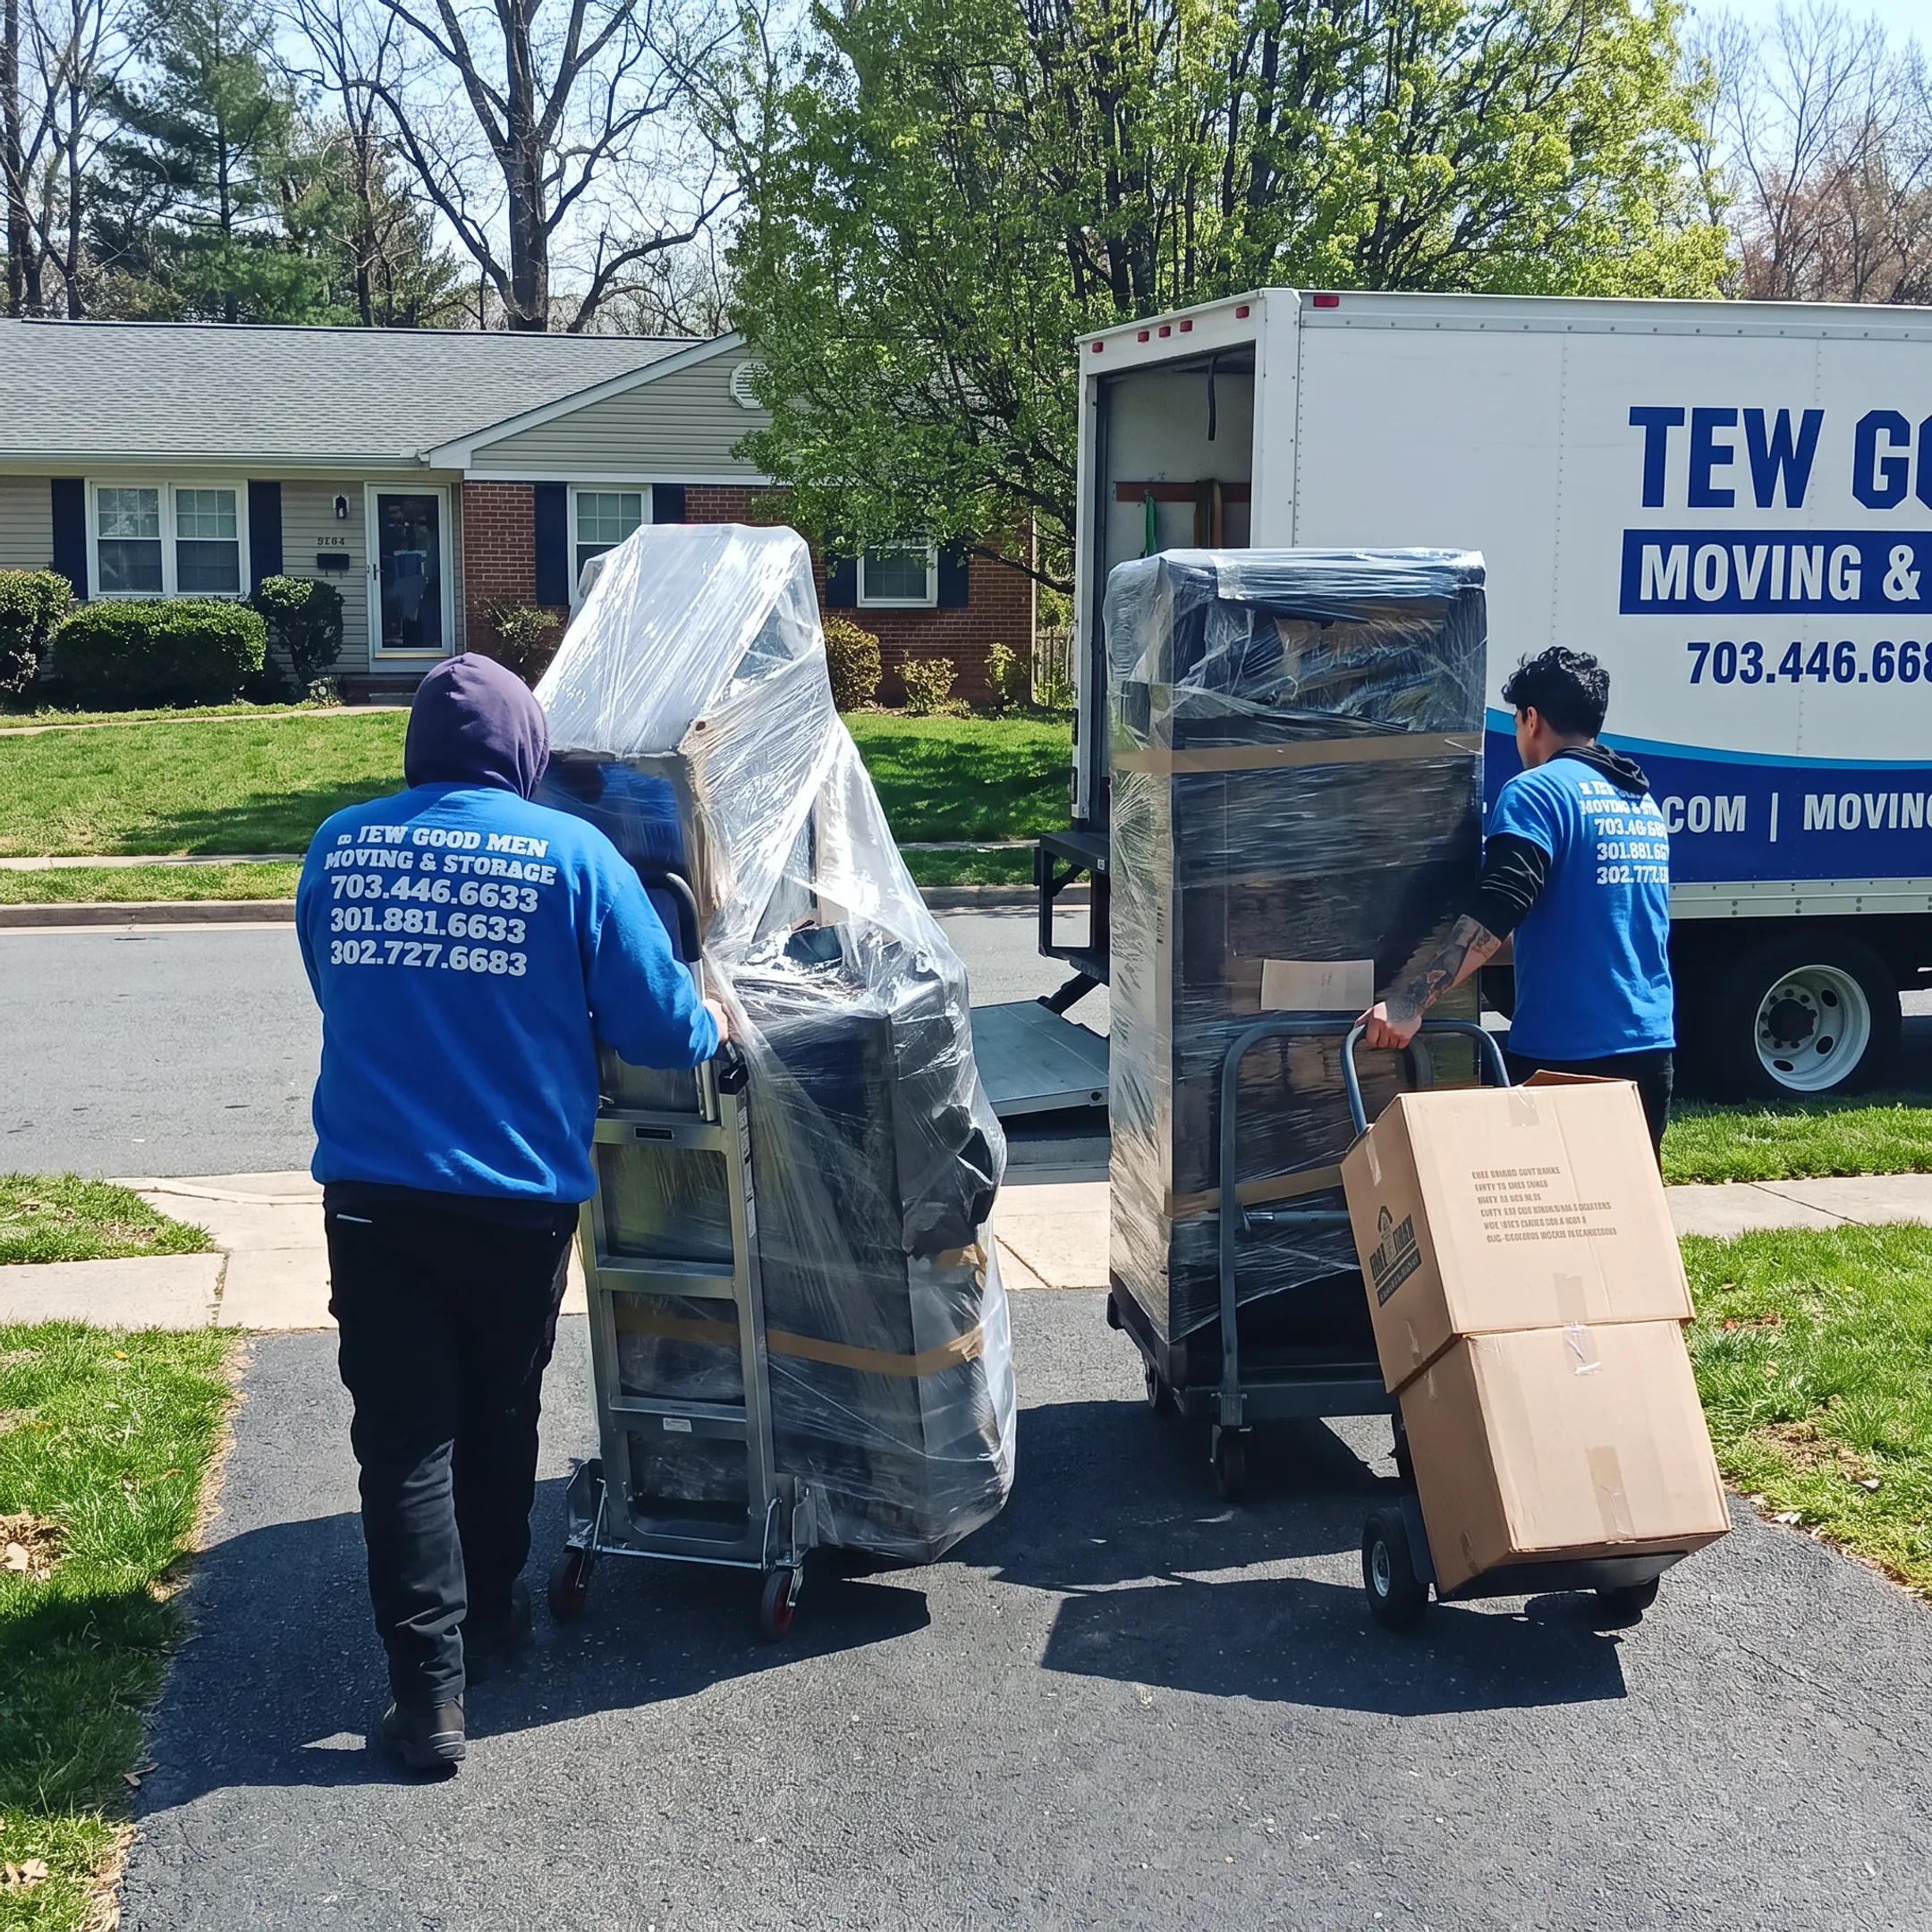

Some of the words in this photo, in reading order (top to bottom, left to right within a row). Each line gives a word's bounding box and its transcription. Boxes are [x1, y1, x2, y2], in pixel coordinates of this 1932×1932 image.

[1628, 406, 1825, 509] TEW
[1852, 409, 1932, 510] G
[1640, 544, 1862, 601] MOVING
[1882, 544, 1921, 601] &
[1803, 792, 1932, 830] MOVIN
[411, 827, 481, 851] GOOD
[485, 833, 549, 859] MEN
[324, 849, 414, 870] MOVING
[419, 852, 437, 871] &
[443, 854, 556, 886] STORAGE
[330, 874, 538, 912] 703.446.6633
[330, 906, 527, 944] 301.881.6633
[330, 939, 528, 977] 302.727.6683
